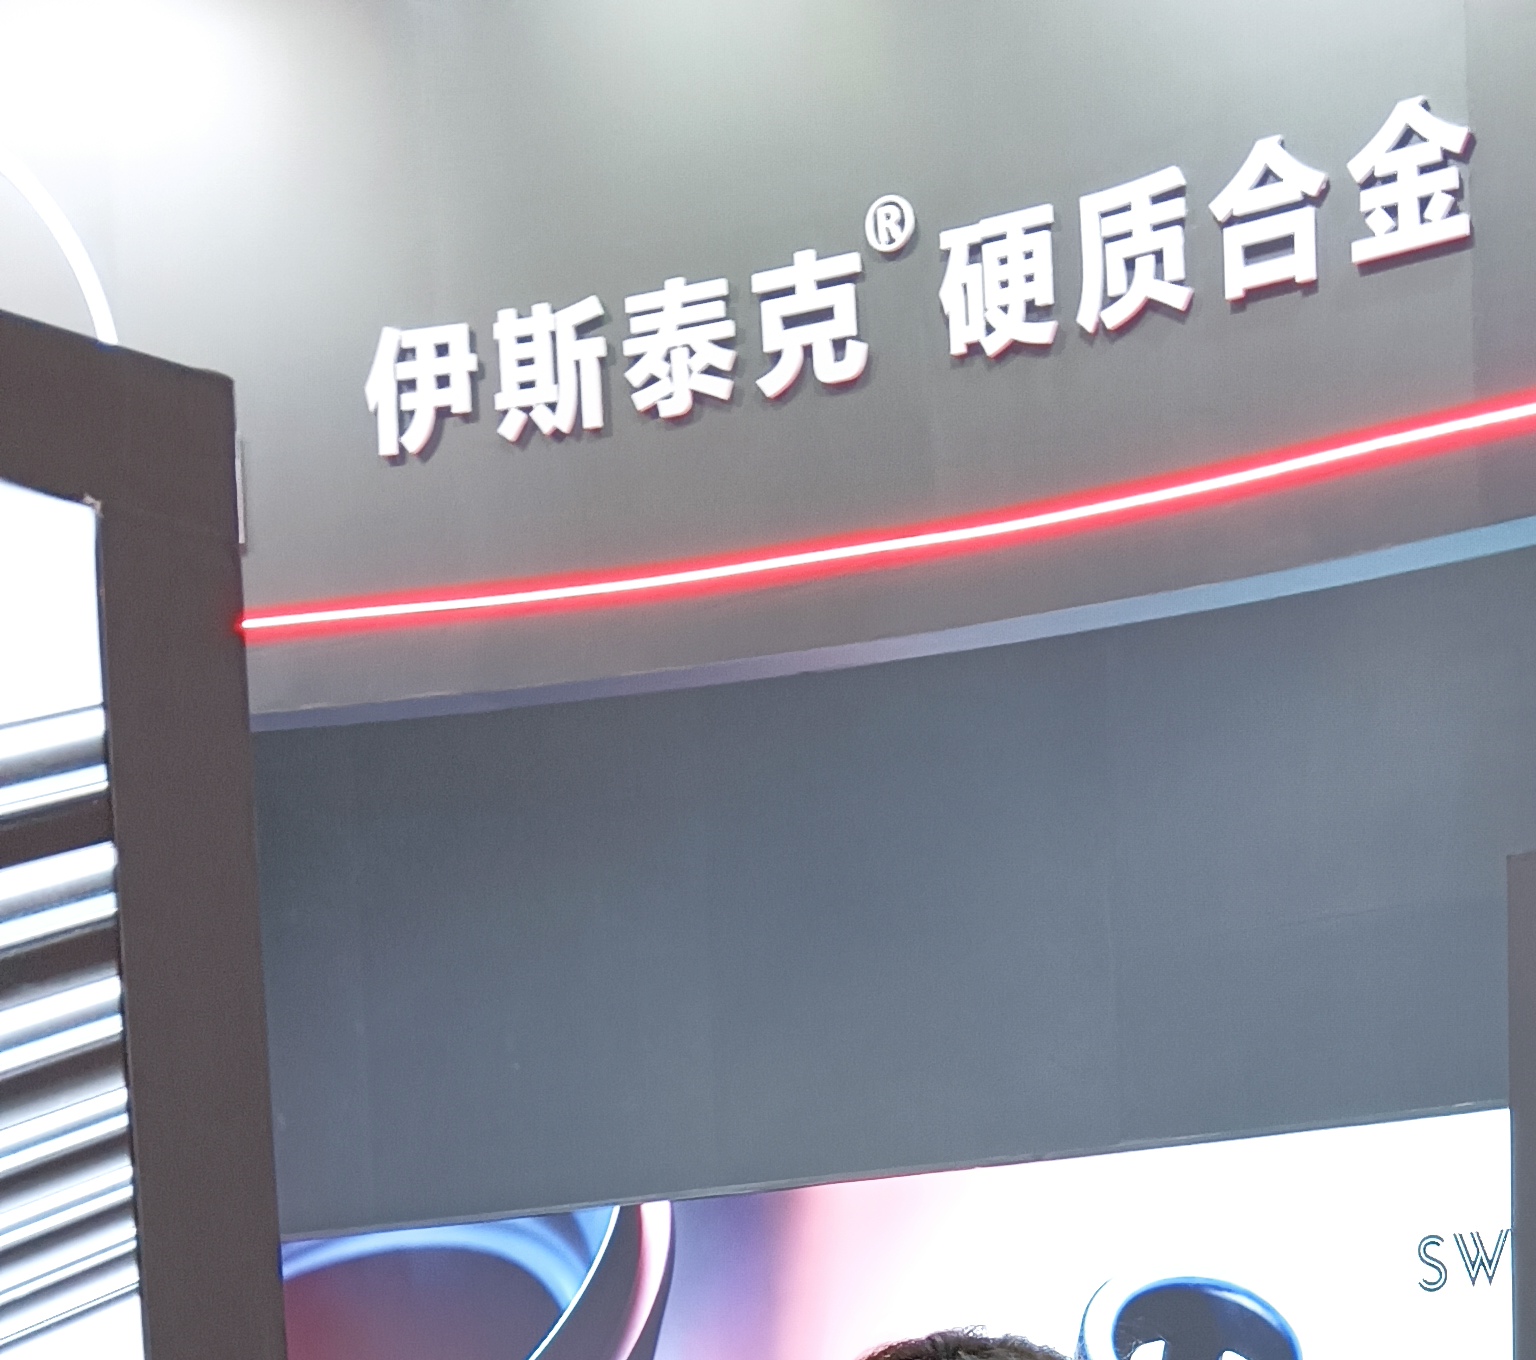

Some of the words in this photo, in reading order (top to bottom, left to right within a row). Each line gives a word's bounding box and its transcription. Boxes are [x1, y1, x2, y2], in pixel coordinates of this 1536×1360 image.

[938, 95, 1471, 359] 硬质合金
[1418, 1228, 1512, 1292] SW
